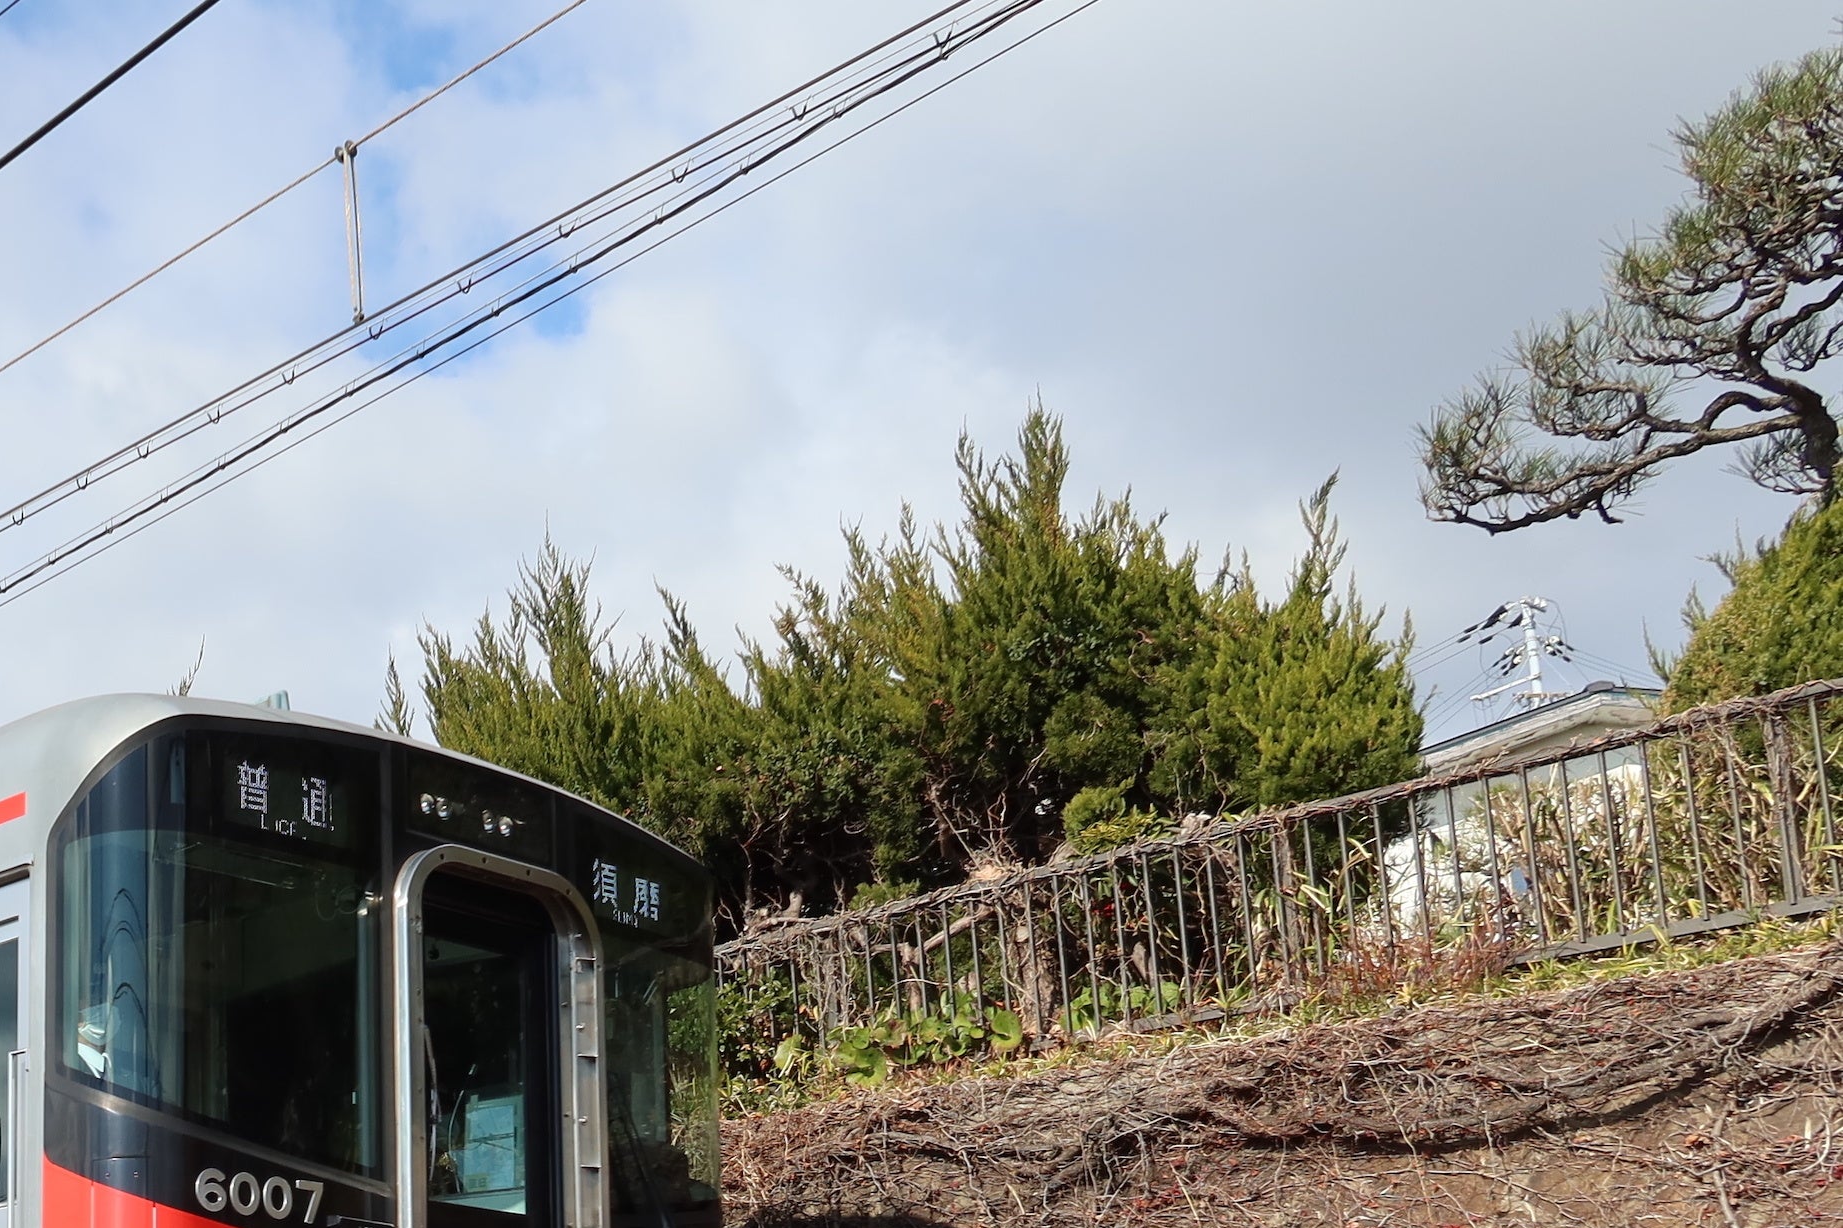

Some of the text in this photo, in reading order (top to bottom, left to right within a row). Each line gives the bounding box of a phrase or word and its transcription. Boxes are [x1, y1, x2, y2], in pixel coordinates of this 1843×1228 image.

[237, 760, 335, 831] 普通
[593, 858, 659, 921] 須磨
[195, 1167, 324, 1225] 6007
